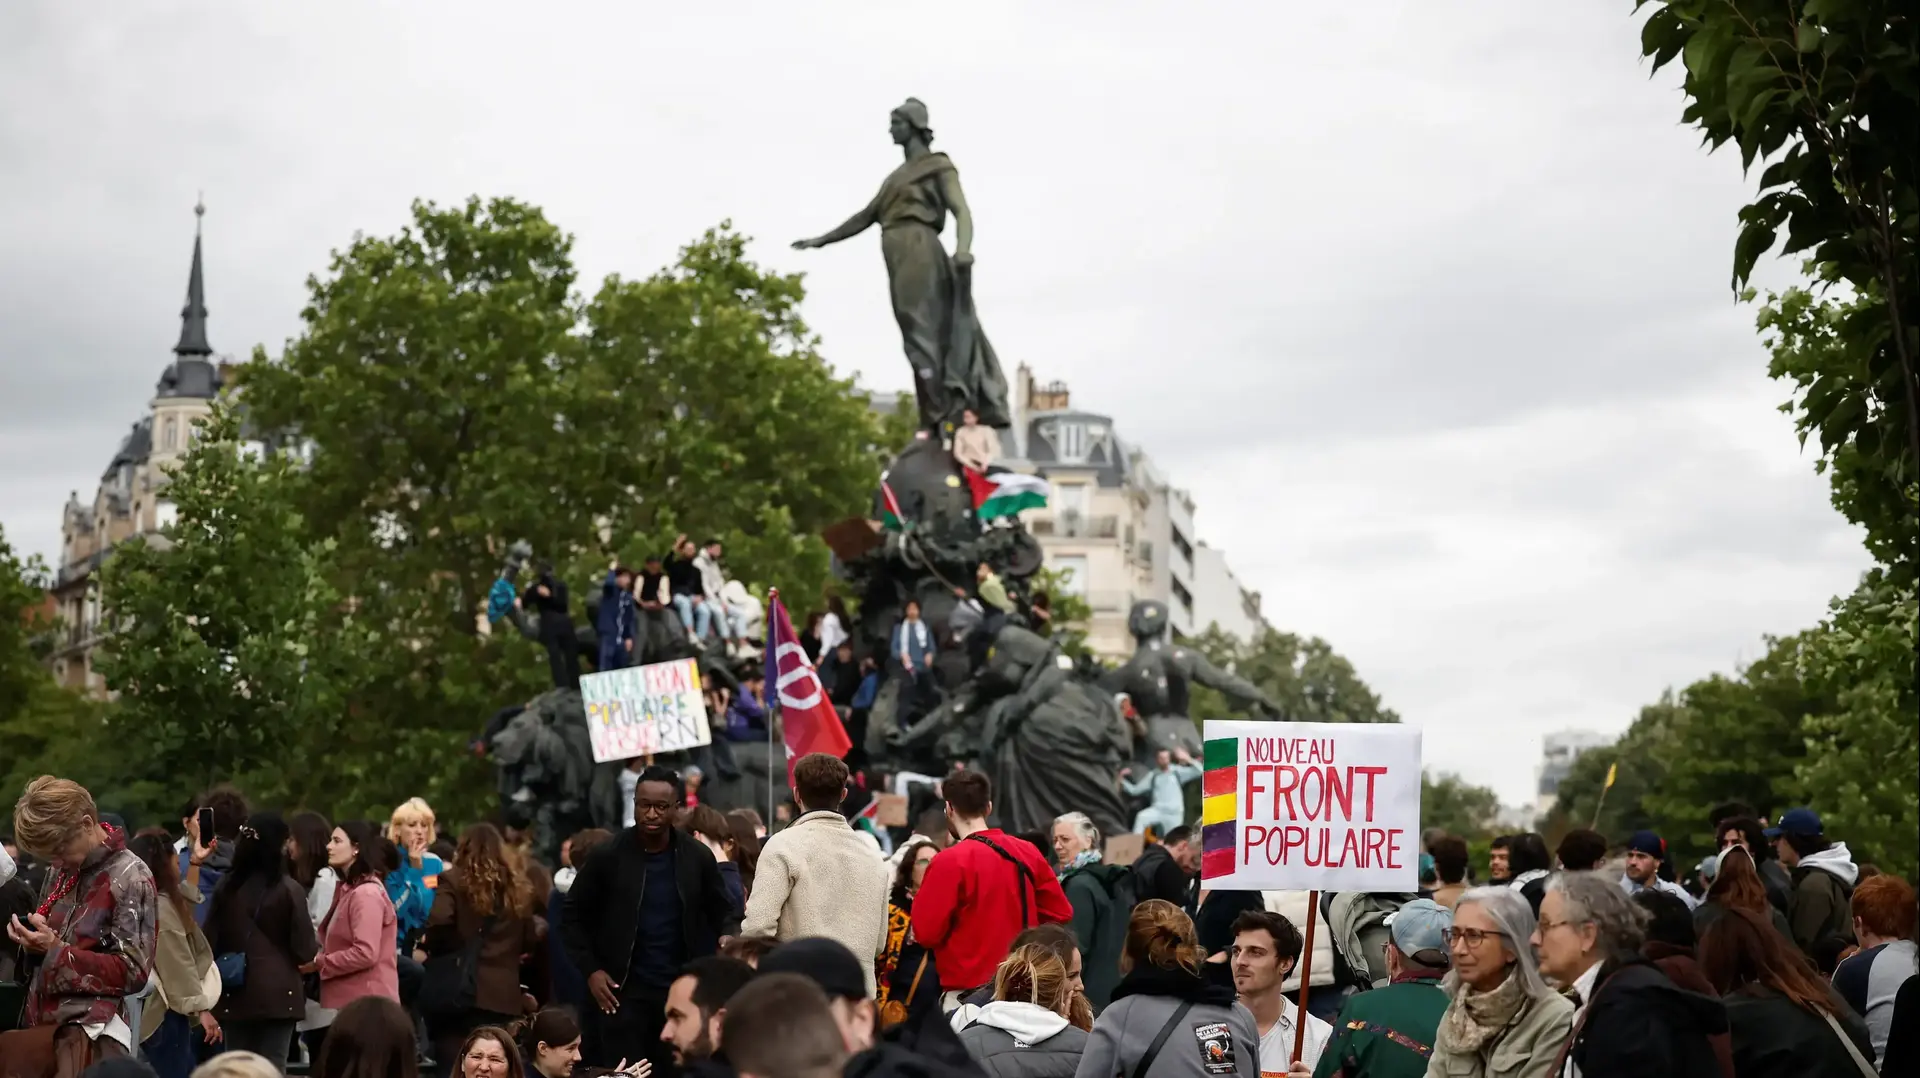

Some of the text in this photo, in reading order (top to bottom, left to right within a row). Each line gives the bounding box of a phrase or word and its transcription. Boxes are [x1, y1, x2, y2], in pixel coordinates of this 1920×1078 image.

[588, 693, 688, 729] POPULAIRE
[658, 716, 700, 747] RN
[1246, 737, 1335, 764] NOUVEAU
[1245, 765, 1388, 823] FRONT
[1244, 825, 1404, 869] POPULAIRE
